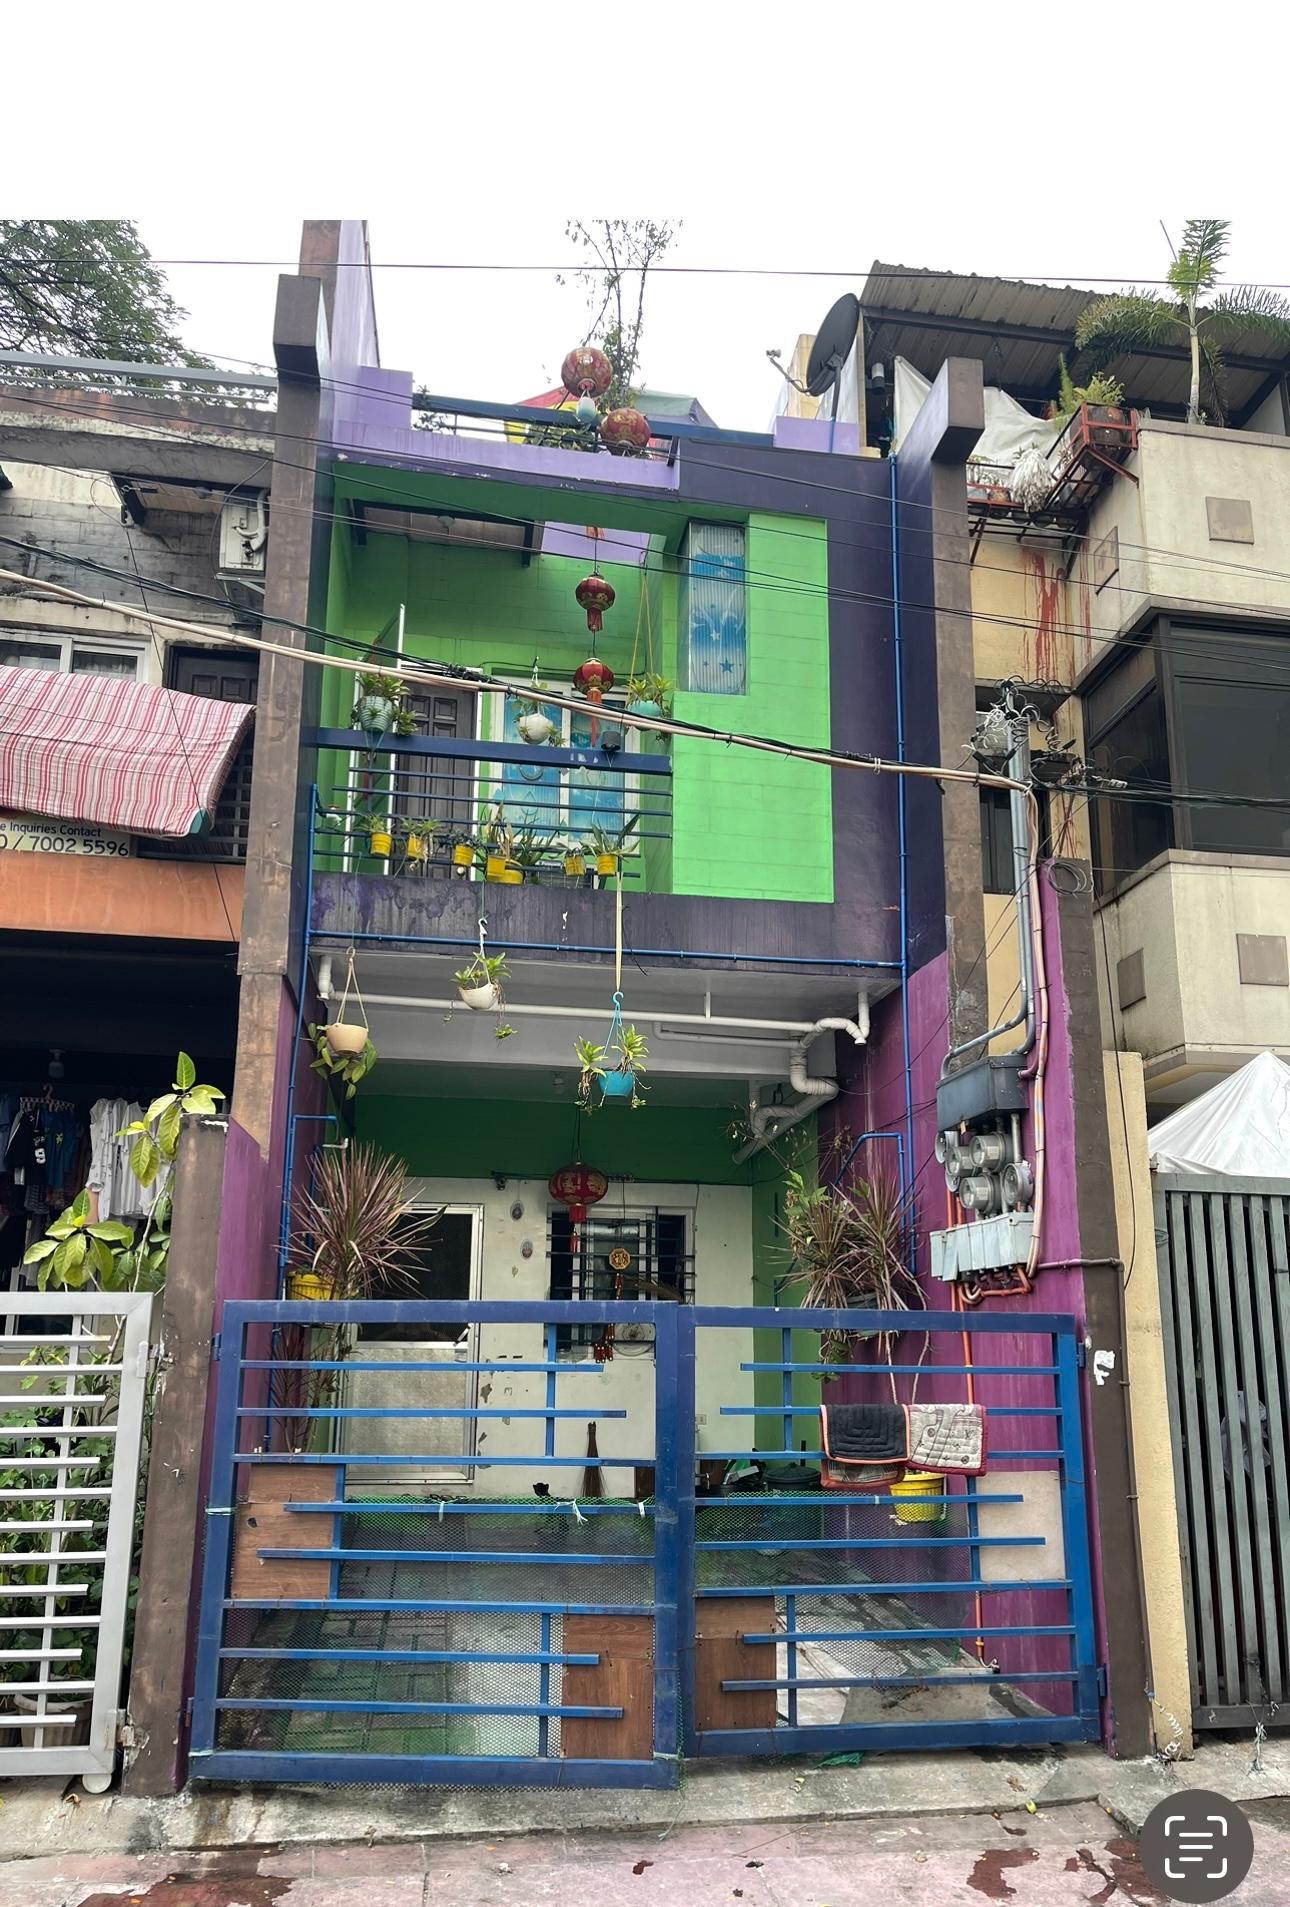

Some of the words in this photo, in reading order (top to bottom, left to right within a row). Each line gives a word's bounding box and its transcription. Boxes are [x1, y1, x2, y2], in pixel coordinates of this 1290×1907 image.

[10, 821, 56, 834] Inquiries
[60, 825, 101, 837] Contact
[29, 836, 77, 853] 7002
[83, 839, 128, 856] 5596
